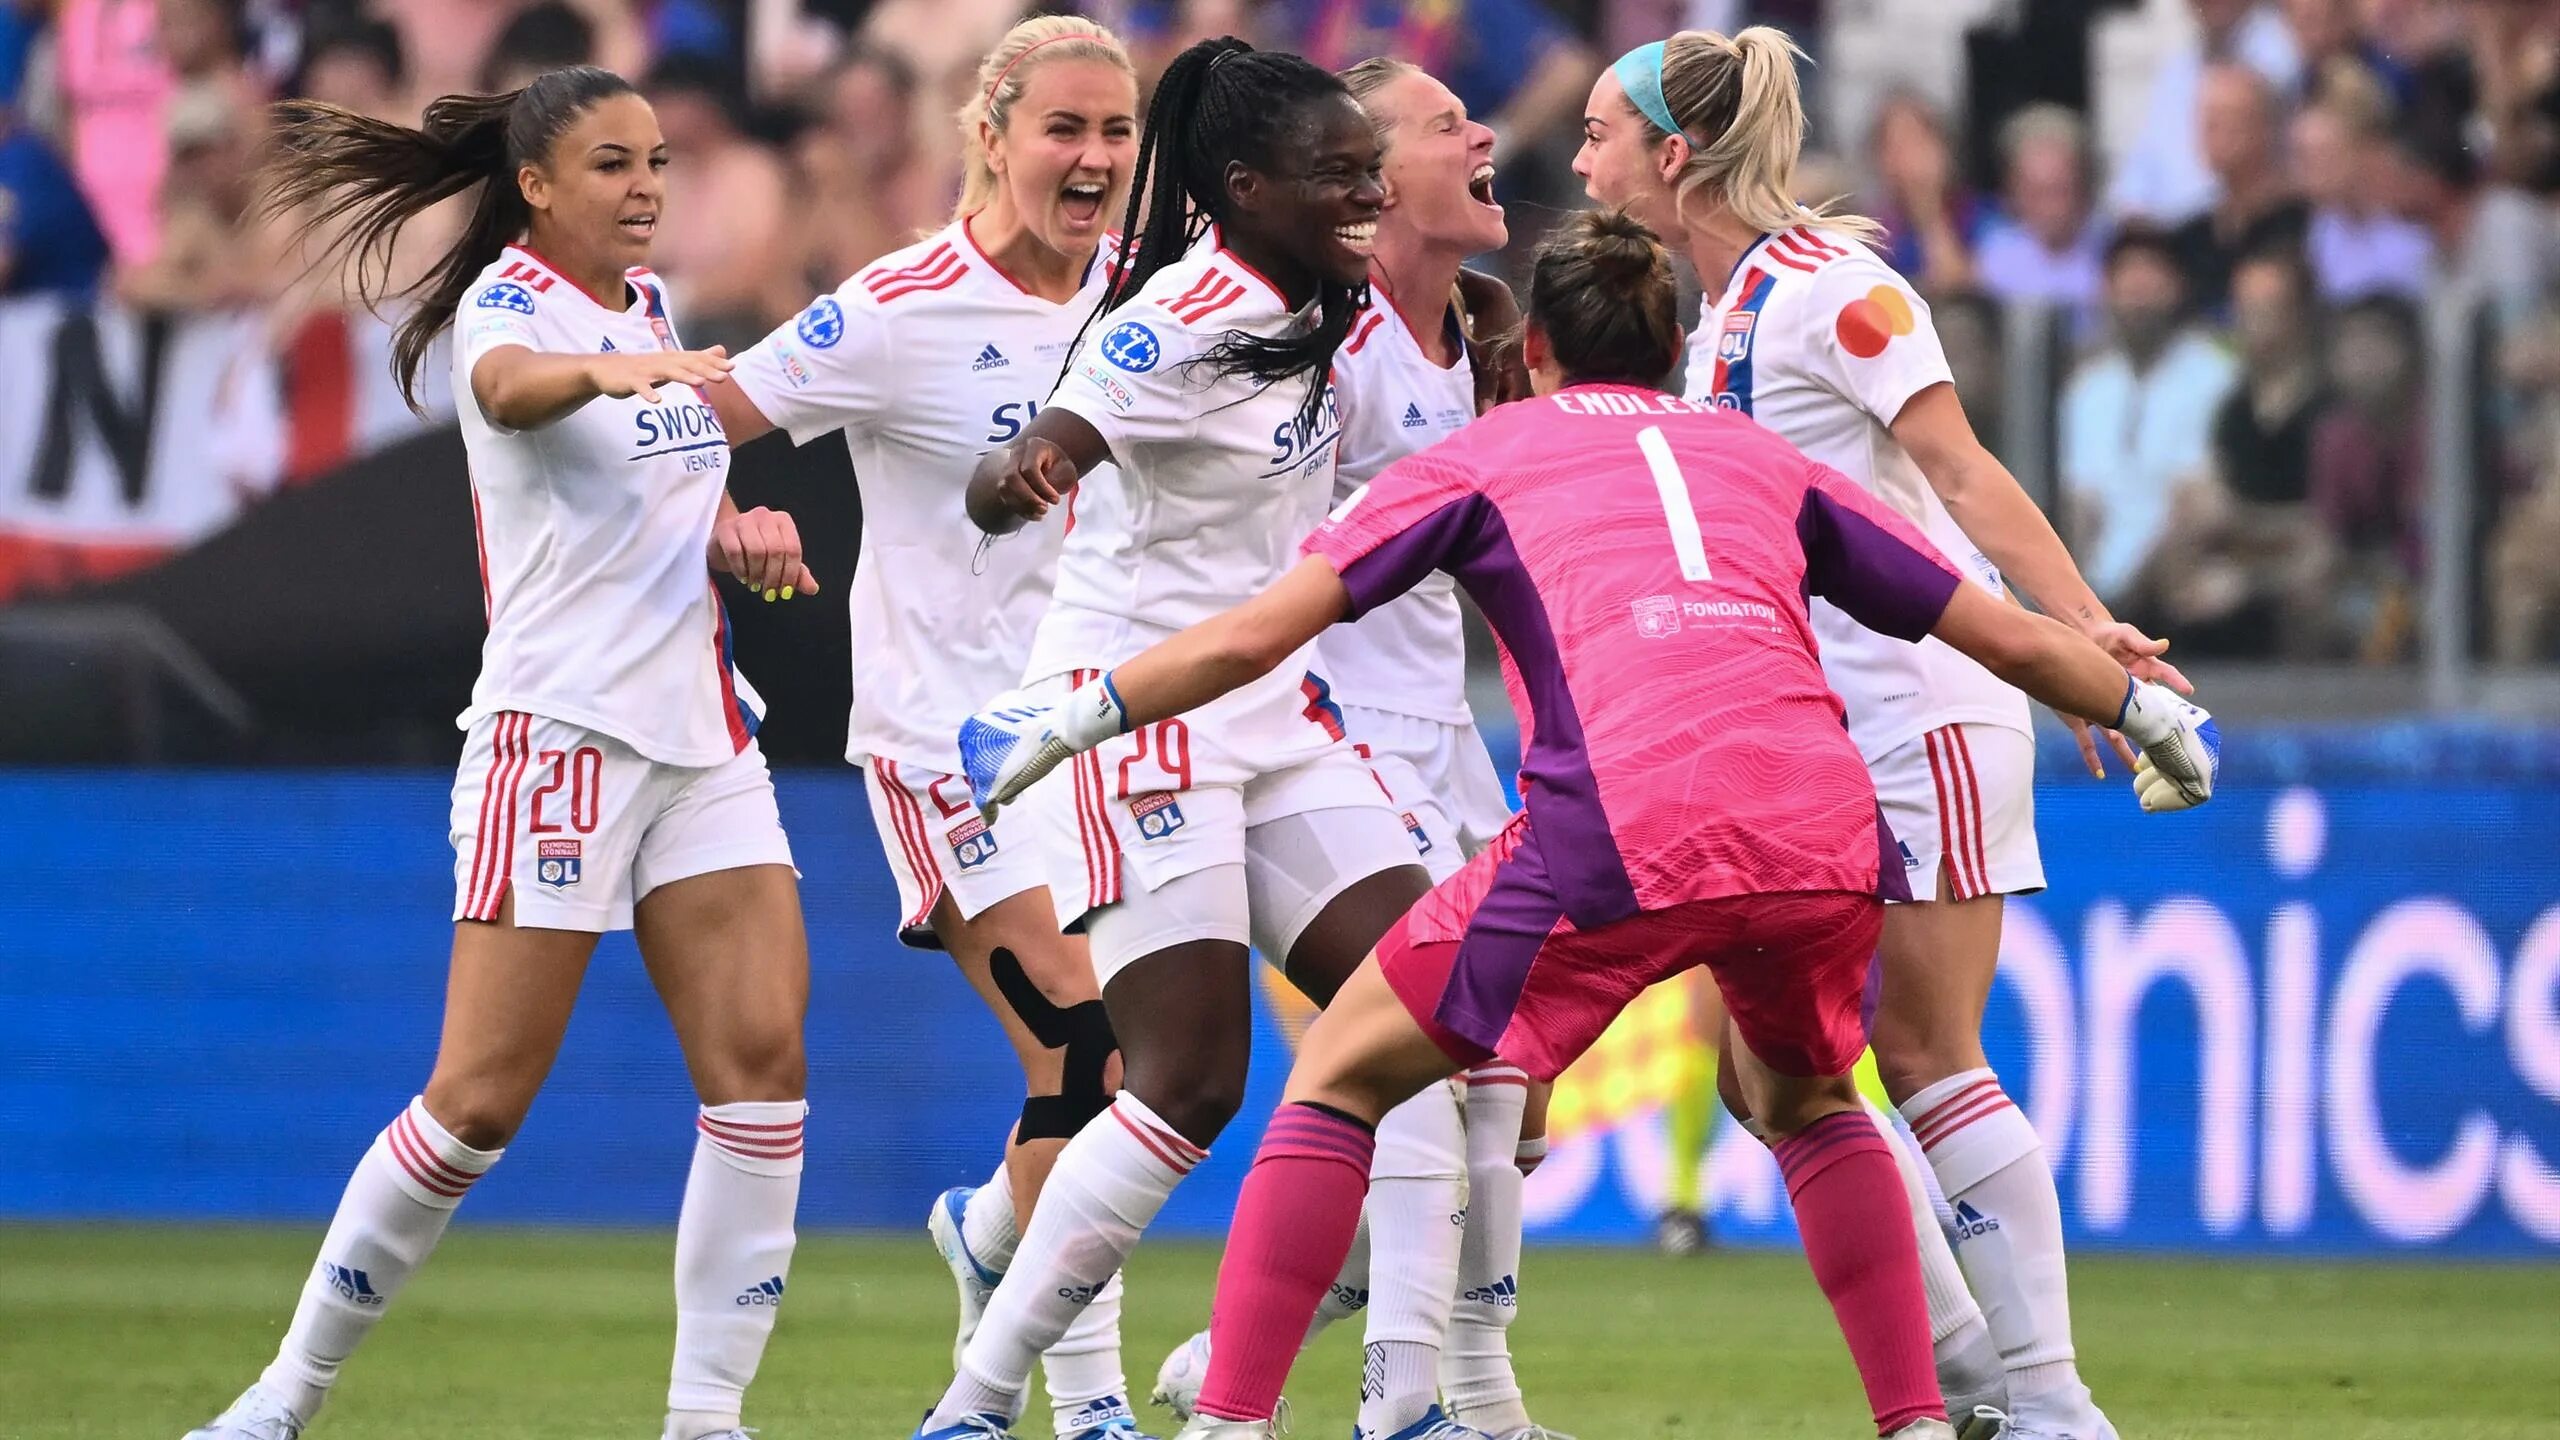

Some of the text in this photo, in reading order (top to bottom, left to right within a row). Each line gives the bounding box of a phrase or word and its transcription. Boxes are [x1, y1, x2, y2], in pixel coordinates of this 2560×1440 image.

[972, 357, 1010, 372] adidas
[635, 404, 723, 447] SWOR
[1269, 386, 1342, 464] SWOR
[1636, 425, 1713, 582] 1
[529, 746, 603, 834] 20
[927, 773, 977, 821] 2
